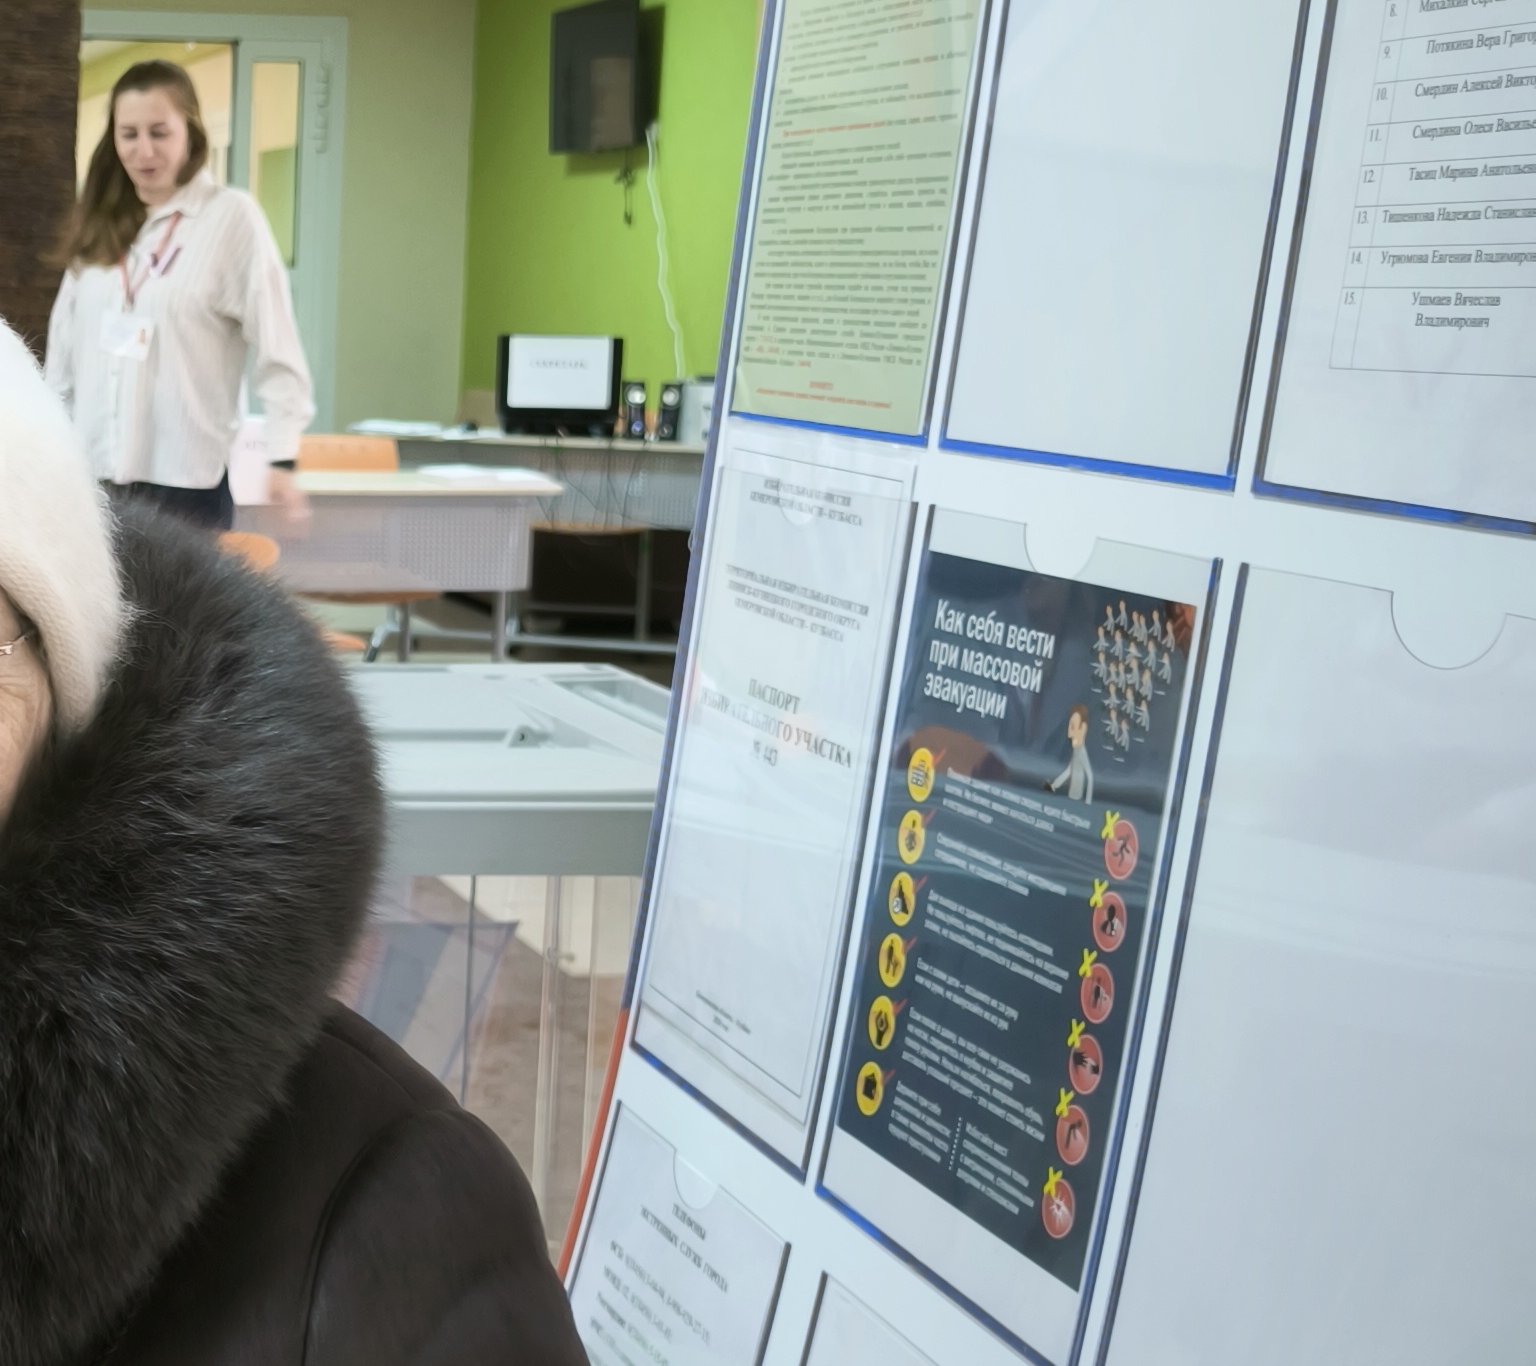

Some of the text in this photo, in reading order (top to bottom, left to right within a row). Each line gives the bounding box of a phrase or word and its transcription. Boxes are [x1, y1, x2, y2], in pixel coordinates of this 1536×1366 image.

[1475, 32, 1501, 52] Вера
[1460, 75, 1504, 93] Алексей
[1463, 120, 1495, 136] Олеся
[1436, 207, 1482, 222] Надежда
[1380, 250, 1429, 268] Угрюмова
[1454, 292, 1502, 307] Вячеслав
[1414, 312, 1491, 332] Владимирович
[934, 597, 1055, 661] Как себя вести
[928, 638, 1043, 694] при массовой
[747, 678, 801, 715] ПАСПОРТ
[922, 671, 1007, 721] эвакуации
[793, 725, 852, 770] УЧАСТКА
